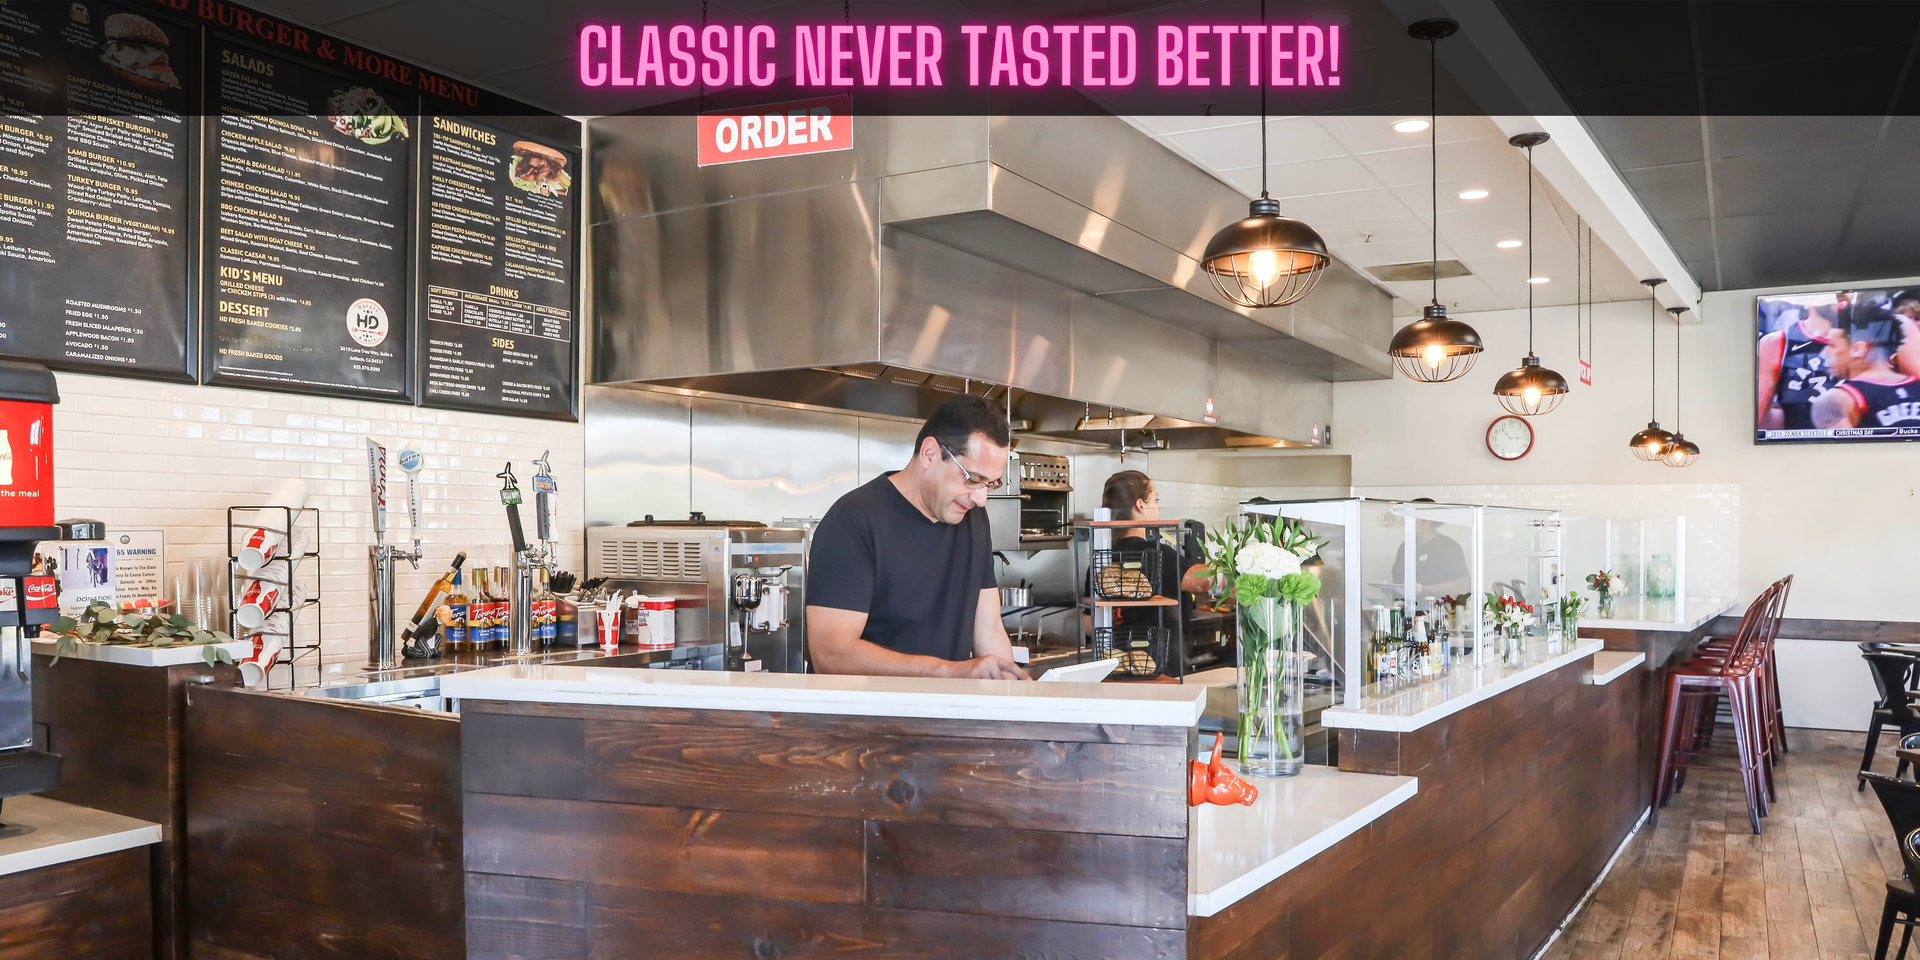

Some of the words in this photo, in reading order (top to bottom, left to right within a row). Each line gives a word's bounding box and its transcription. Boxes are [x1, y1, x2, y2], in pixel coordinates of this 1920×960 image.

[197, 0, 310, 52] BURGER
[317, 38, 336, 60] &
[344, 46, 412, 85] MORE
[418, 70, 478, 107] MENU
[222, 49, 275, 78] SALADS
[221, 68, 241, 80] GREEK
[240, 74, 259, 86] SALAD
[67, 74, 91, 87] CANDY
[92, 81, 116, 94] BACON
[117, 87, 143, 101] BURGER
[67, 107, 97, 121] SMOKED
[97, 114, 125, 128] BRISKET
[126, 122, 151, 134] BURGER
[268, 117, 289, 129] QUINOA
[290, 123, 306, 133] BOWL
[5, 125, 35, 138] BURGER
[433, 116, 496, 147] SANDWICHES
[716, 106, 833, 152] ORDER
[3, 132, 24, 143] Minced
[25, 137, 49, 148] Roasted
[221, 128, 247, 141] CHICKEN
[247, 135, 265, 146] APPLE
[264, 140, 282, 150] SALAD
[67, 147, 88, 158] LAMB
[88, 152, 116, 164] BURGER
[220, 153, 246, 165] SALMON
[252, 160, 267, 170] BEAN
[267, 164, 285, 175] SALAD
[3, 174, 29, 185] Cheddar
[30, 179, 53, 190] Cheese,
[68, 174, 95, 186] TURKEY
[95, 180, 122, 192] BURGER
[220, 178, 245, 189] CHINESE
[244, 183, 270, 195] CHICKEN
[270, 189, 288, 199] SALAD
[4, 194, 34, 206] BURGER
[4, 202, 22, 212] House
[23, 206, 37, 214] Cole
[67, 208, 95, 220] QUINOA
[96, 213, 122, 225] BURGER
[220, 203, 233, 211] BBQ
[233, 206, 259, 217] CHICKEN
[258, 211, 277, 220] SALAD
[470, 210, 492, 220] SANDWICH
[220, 227, 234, 236] BEET
[234, 229, 253, 240] SALAD
[254, 233, 268, 242] WITH
[268, 236, 283, 245] GOAT
[283, 239, 303, 249] CHEESE
[431, 222, 451, 232] CHICKEN
[465, 230, 487, 240] SANDWICH
[4, 243, 27, 253] Lettuce,
[27, 247, 51, 257] Tomato,
[7, 251, 27, 260] Sauce,
[28, 254, 56, 264] American
[220, 246, 244, 257] CLASSIC
[244, 250, 266, 261] CAESAR
[220, 265, 251, 282] KID'S
[252, 271, 284, 287] MENU
[220, 280, 244, 290] GRILLED
[244, 284, 265, 293] CHEESE
[227, 288, 251, 297] CHICKEN
[490, 284, 519, 300] DRINKS
[66, 299, 91, 308] ROASTED
[91, 303, 126, 313] MUSHROOMS
[219, 300, 270, 319] DESSERT
[66, 320, 82, 328] FRESH
[83, 322, 102, 330] SLICED
[228, 317, 246, 325] FRESH
[246, 319, 264, 328] BAKED
[264, 322, 288, 331] COOKIES
[357, 314, 379, 329] HD
[65, 330, 100, 340] APPLEWOOD
[100, 334, 120, 342] BACON
[492, 337, 514, 350] SIDES
[65, 340, 93, 349] AVOCADO
[228, 349, 245, 357] FRESH
[245, 351, 264, 359] BAKED
[264, 353, 284, 362] GOODS
[28, 583, 54, 593] Coca-Cola
